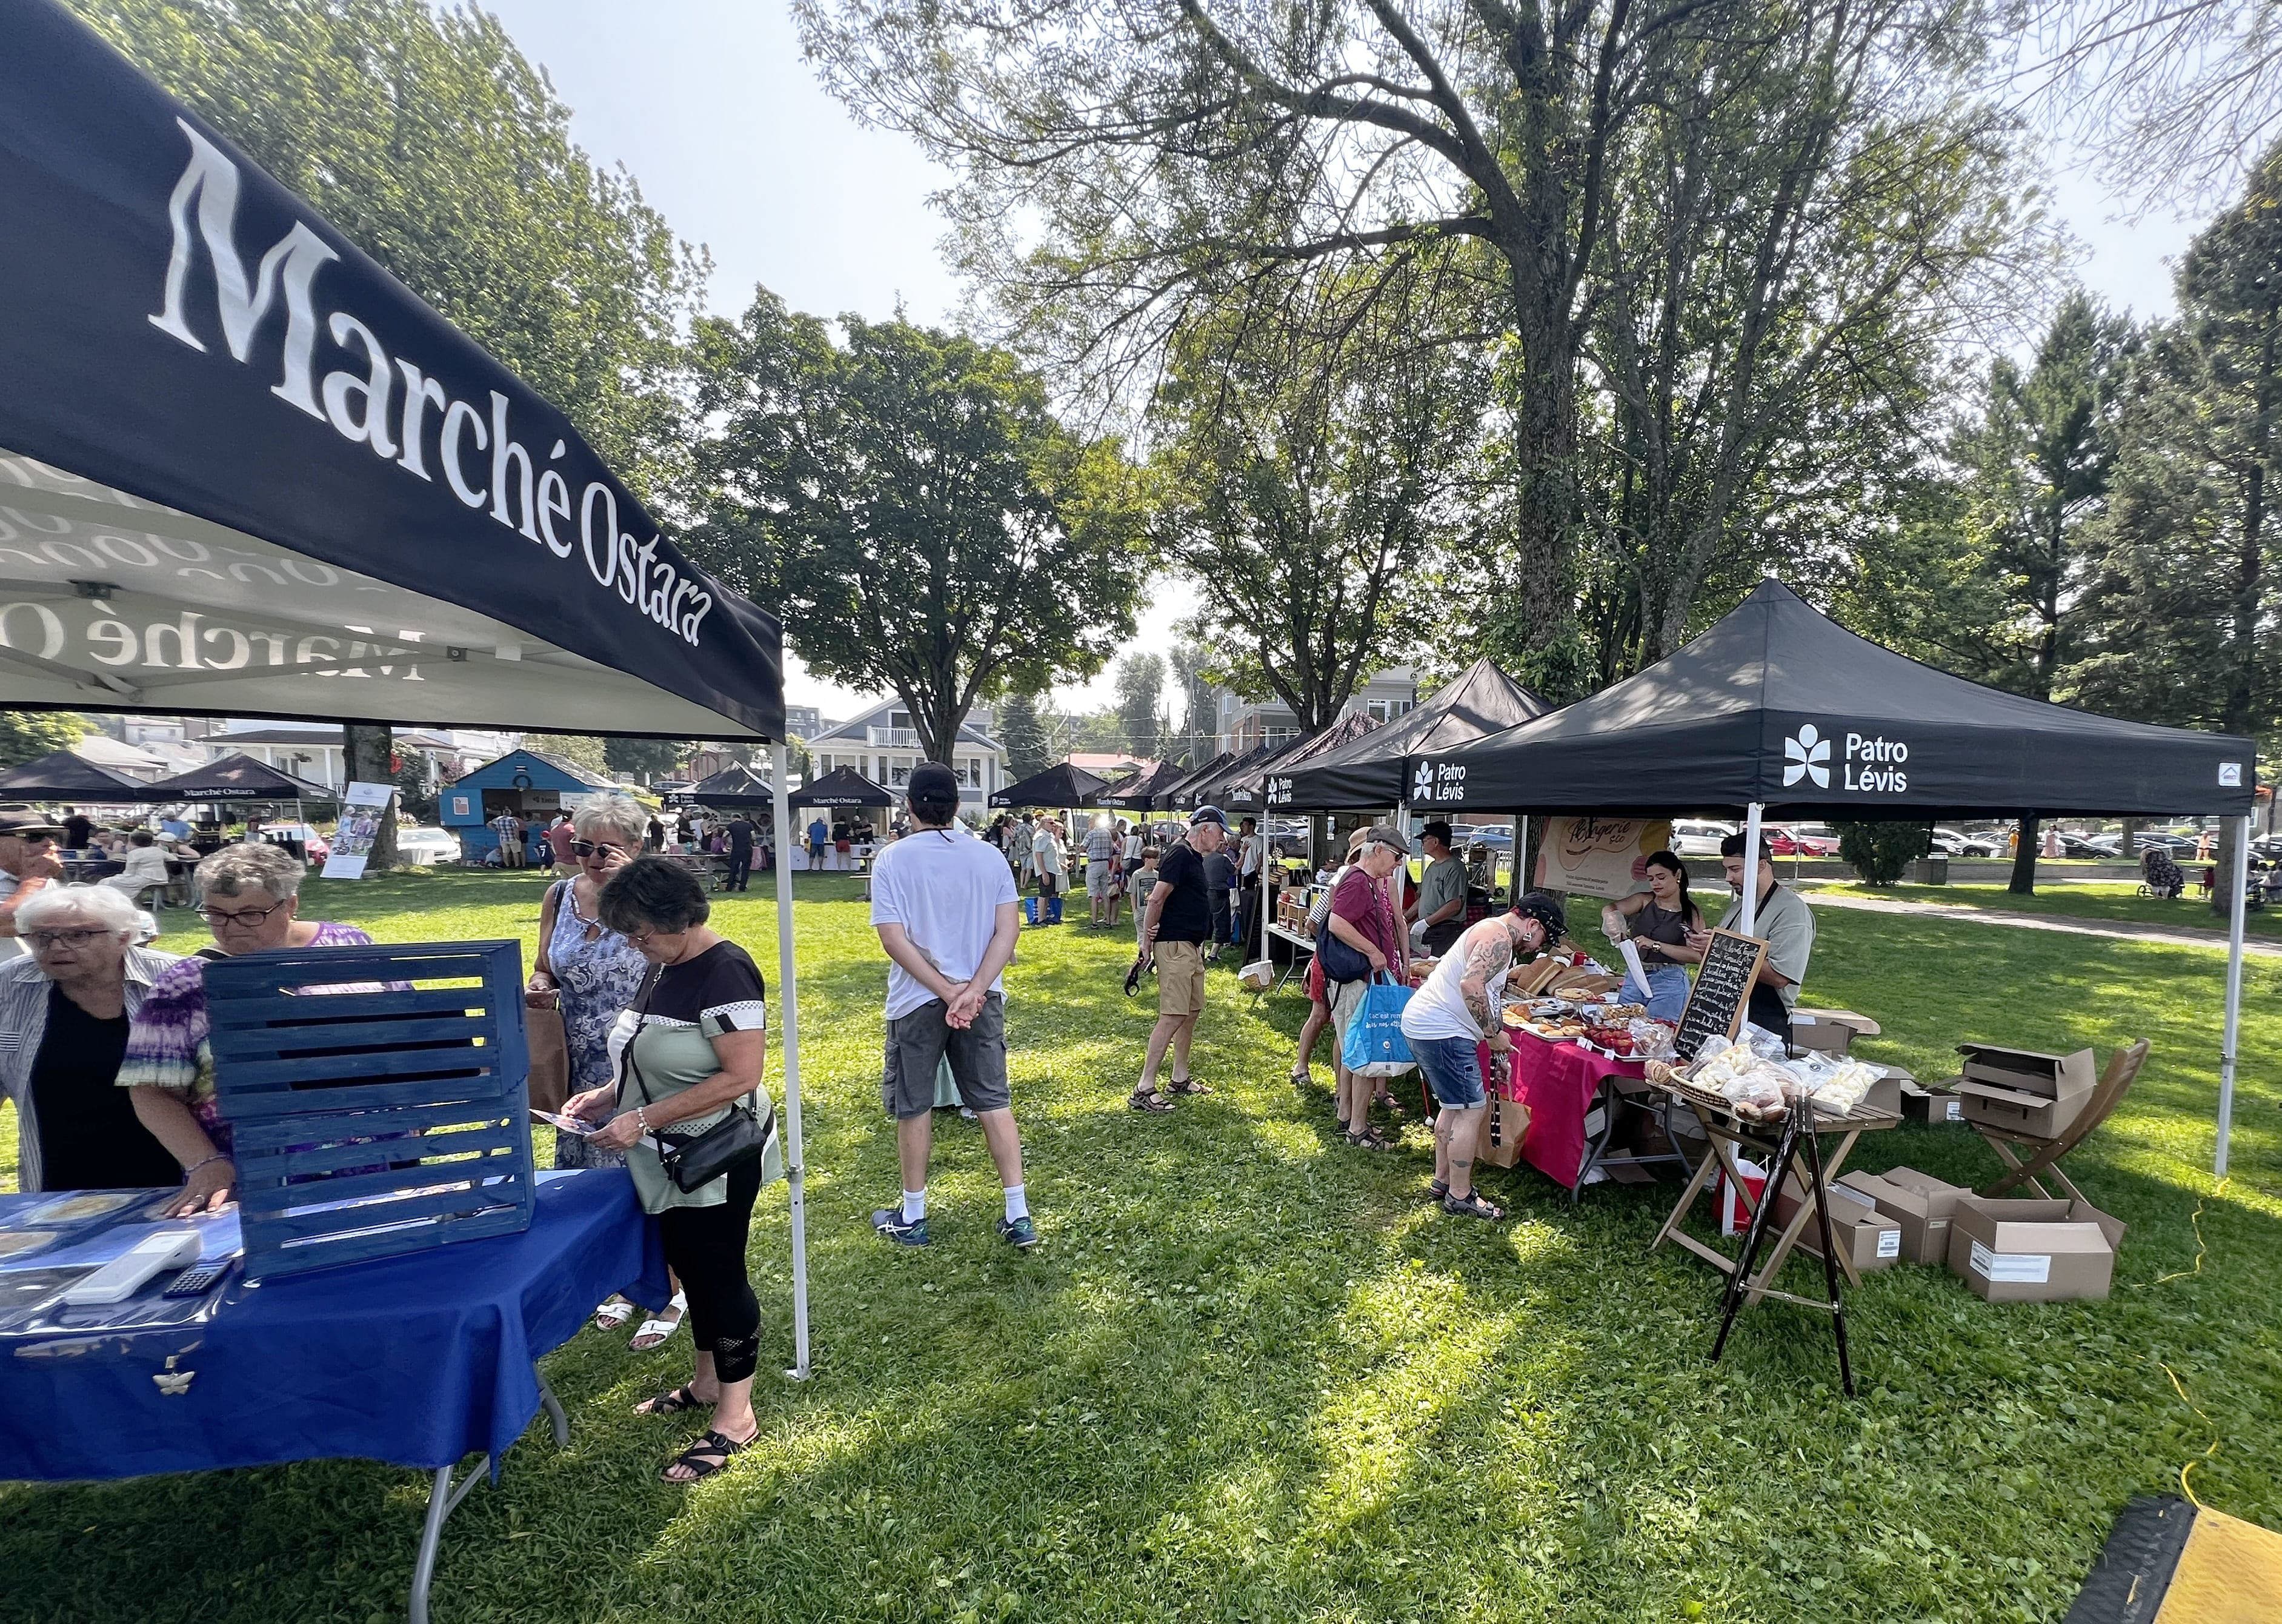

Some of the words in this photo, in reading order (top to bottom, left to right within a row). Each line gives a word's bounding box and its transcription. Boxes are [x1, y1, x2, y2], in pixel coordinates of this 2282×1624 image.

[148, 116, 573, 559] Marché
[580, 481, 713, 647] Ostara
[1846, 733, 1908, 763] Patro
[1438, 763, 1466, 781] Patro
[1845, 764, 1907, 793] Lévis
[184, 788, 222, 797] Marché
[1279, 777, 1292, 790] Patro
[1436, 782, 1464, 800] Lévis
[1279, 790, 1292, 804] Lévis
